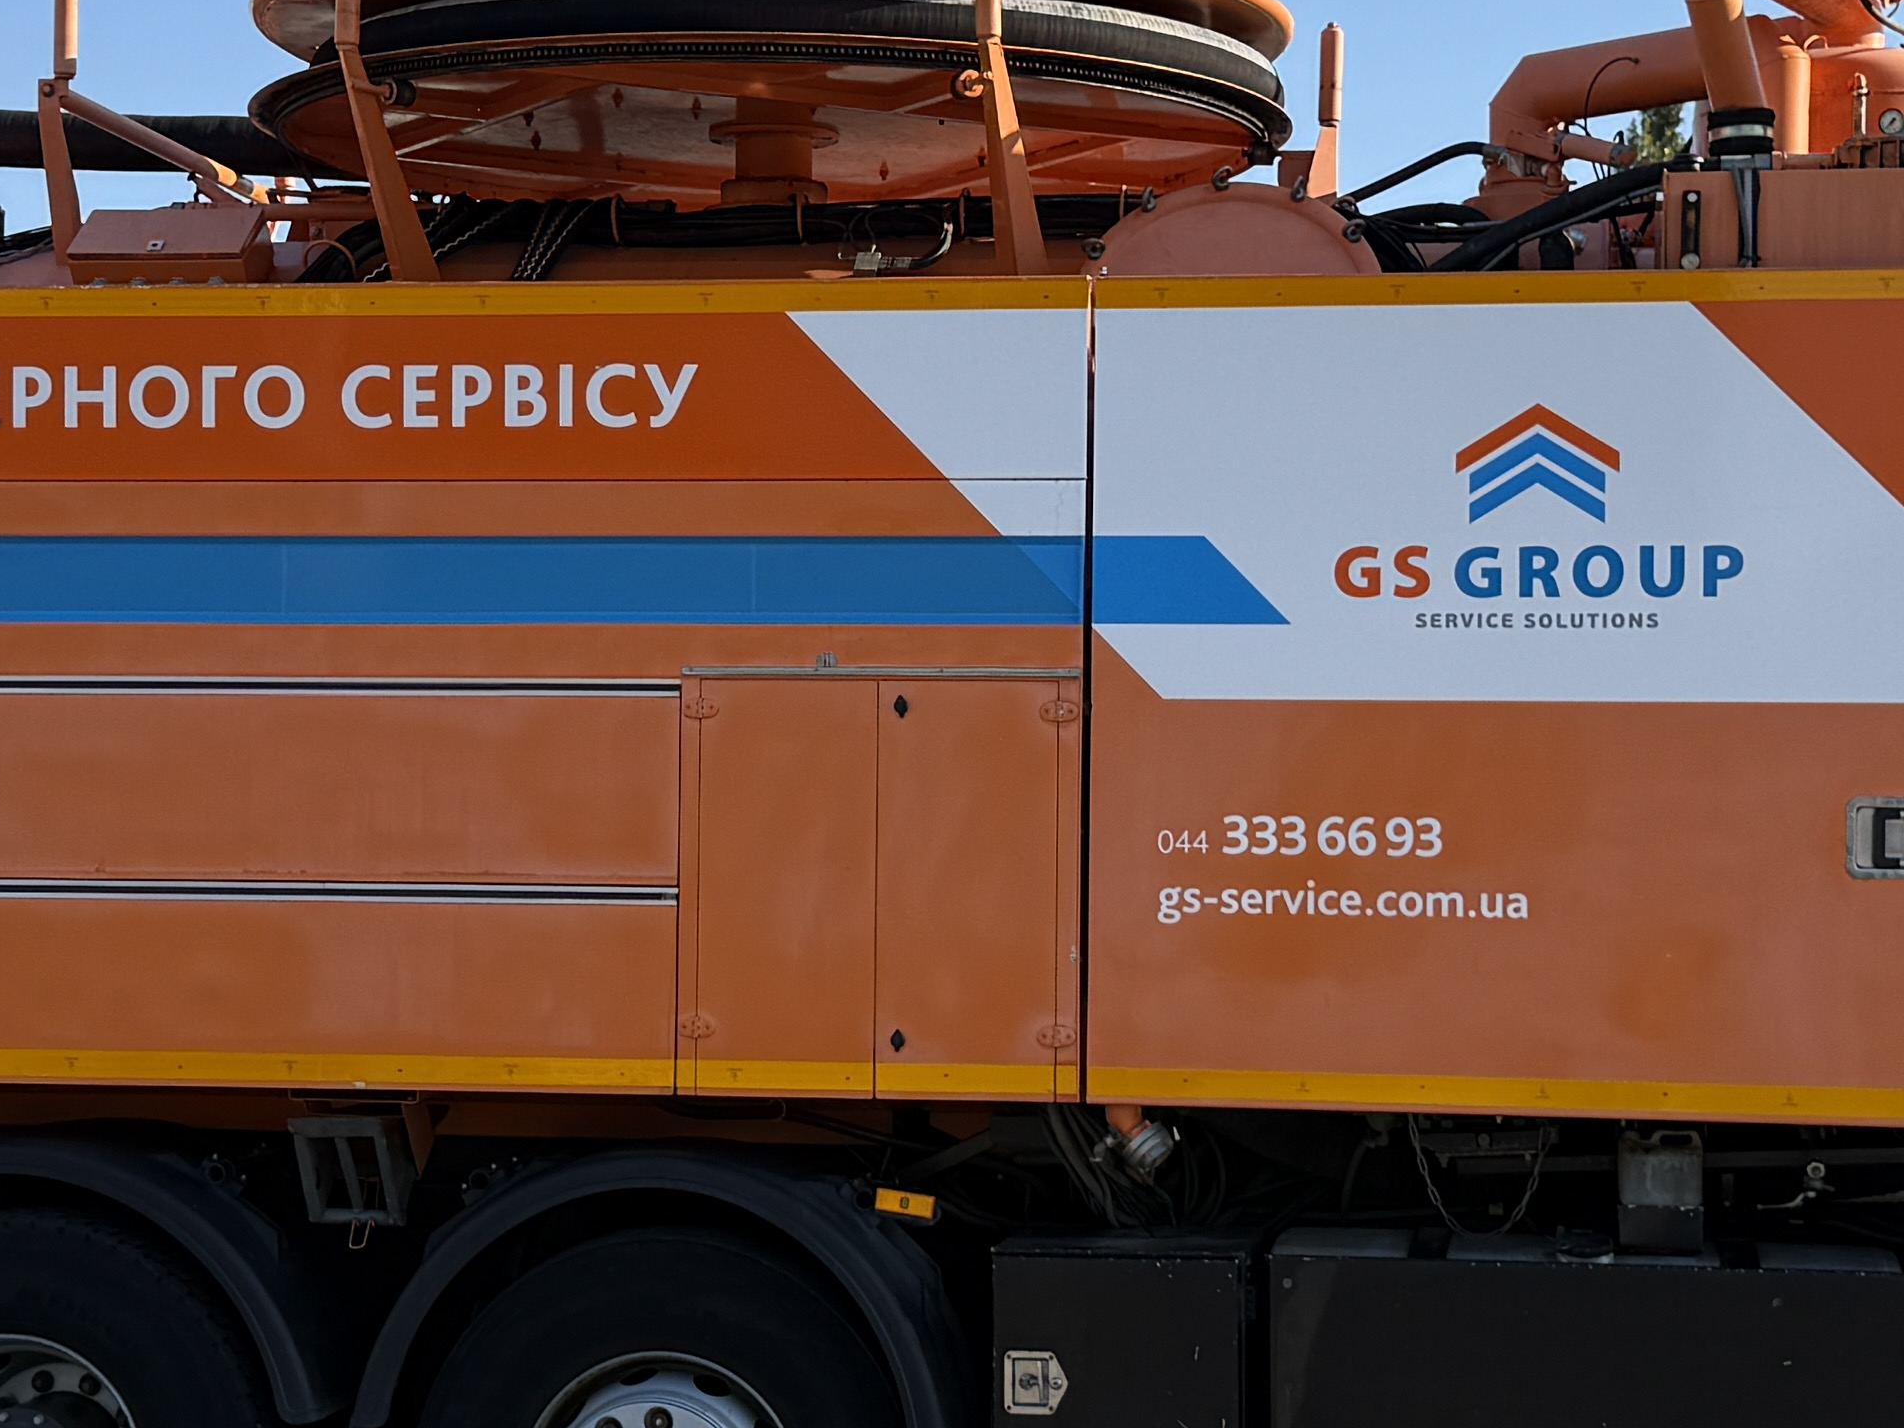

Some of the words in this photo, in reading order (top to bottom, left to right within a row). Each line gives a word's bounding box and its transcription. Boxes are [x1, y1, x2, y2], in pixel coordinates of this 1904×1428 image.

[340, 363, 699, 429] СЕРВІСУ
[1333, 545, 1431, 598] GS
[1454, 545, 1745, 598] GROUP
[1415, 612, 1514, 629] SERVICE
[1524, 612, 1659, 629] SOLUTIONS
[1157, 829, 1209, 855] 044
[1157, 879, 1529, 924] gs-service.com.ua
